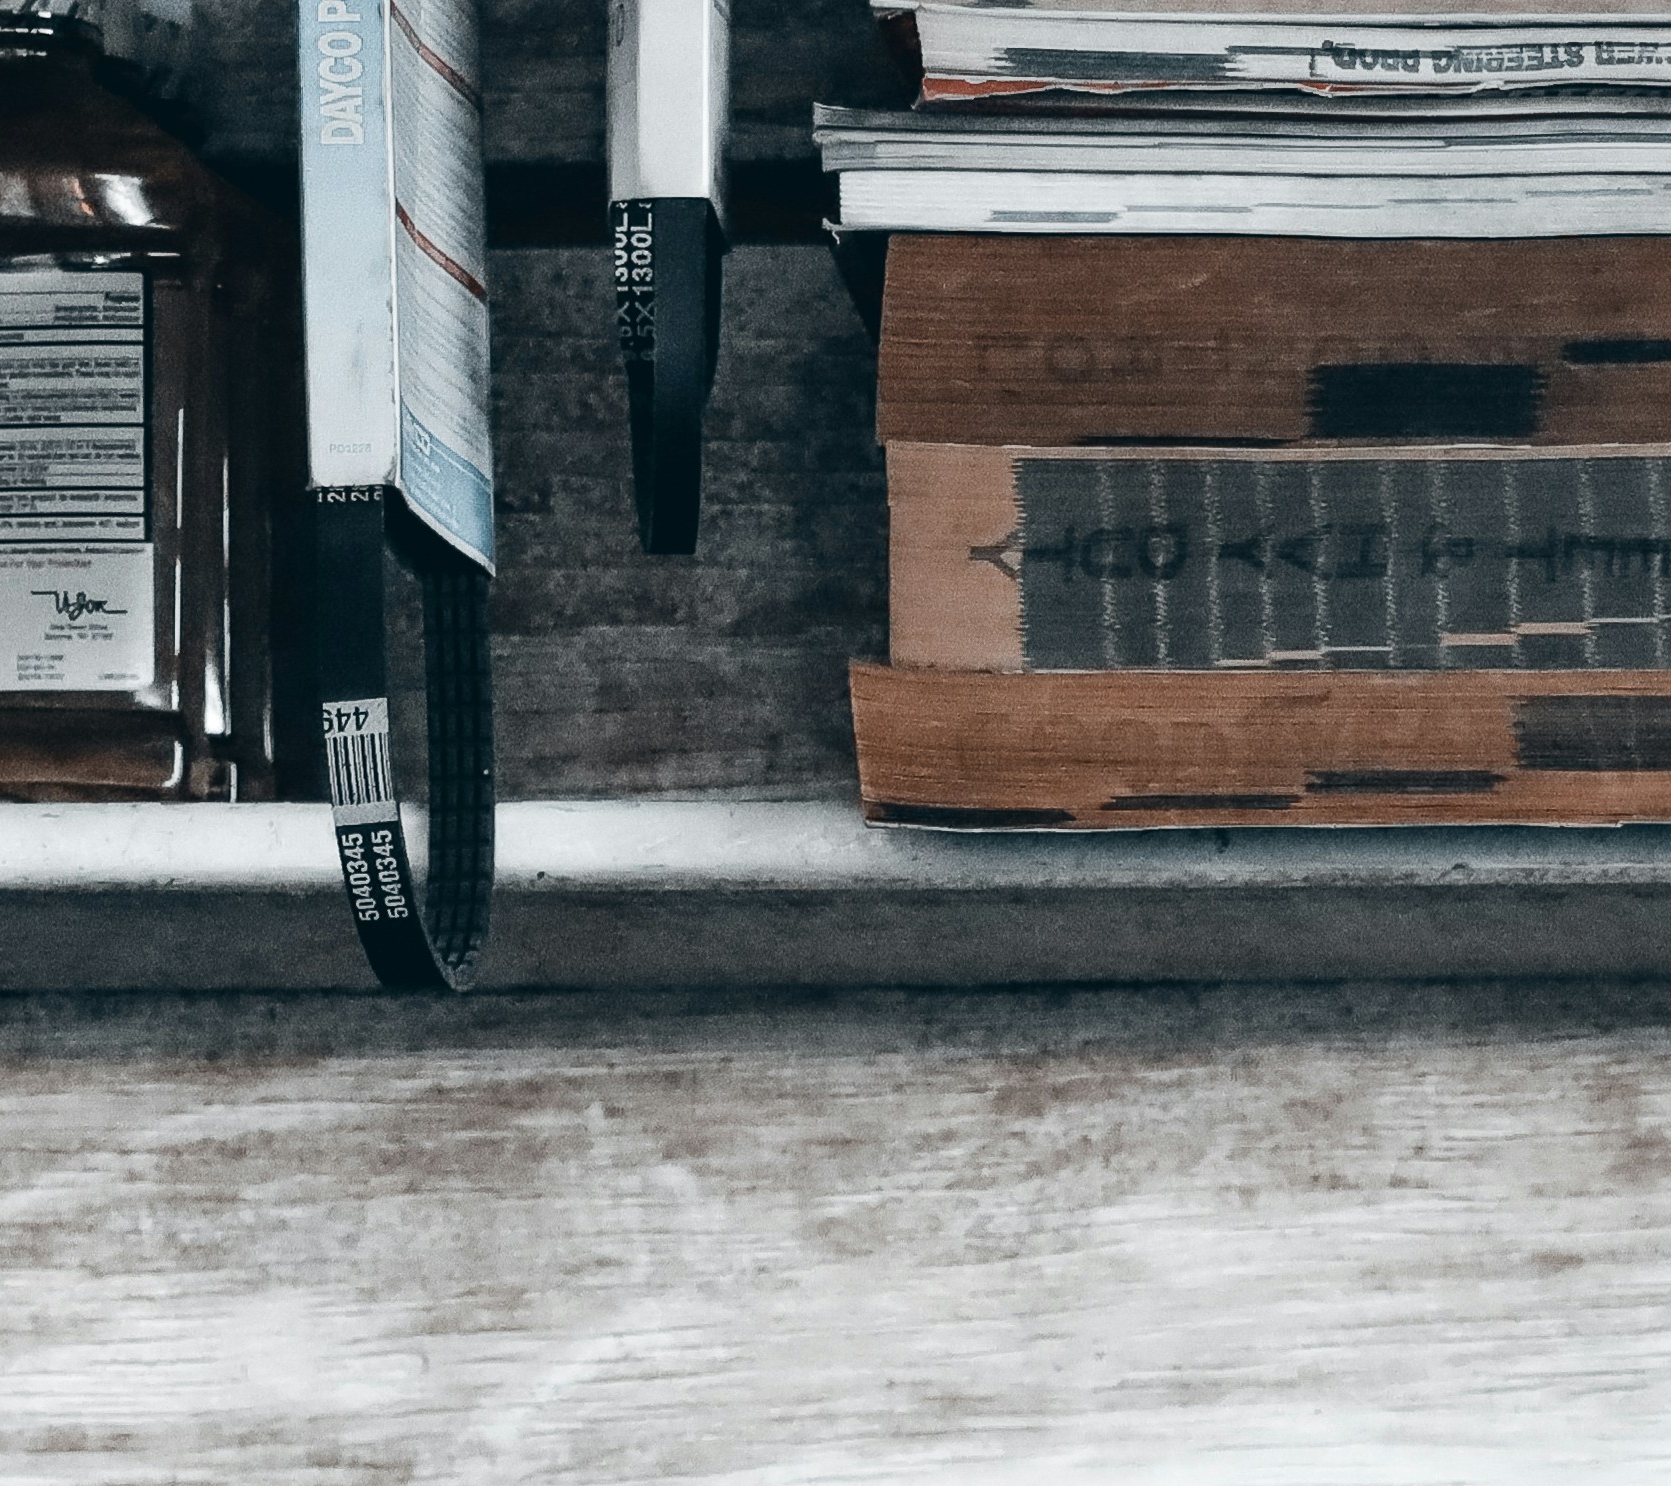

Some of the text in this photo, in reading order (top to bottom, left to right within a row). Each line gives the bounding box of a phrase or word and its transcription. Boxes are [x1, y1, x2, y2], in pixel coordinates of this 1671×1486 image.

[319, 29, 366, 147] DAYCO
[343, 832, 392, 922] 5040345
[373, 828, 415, 920] 5040345
